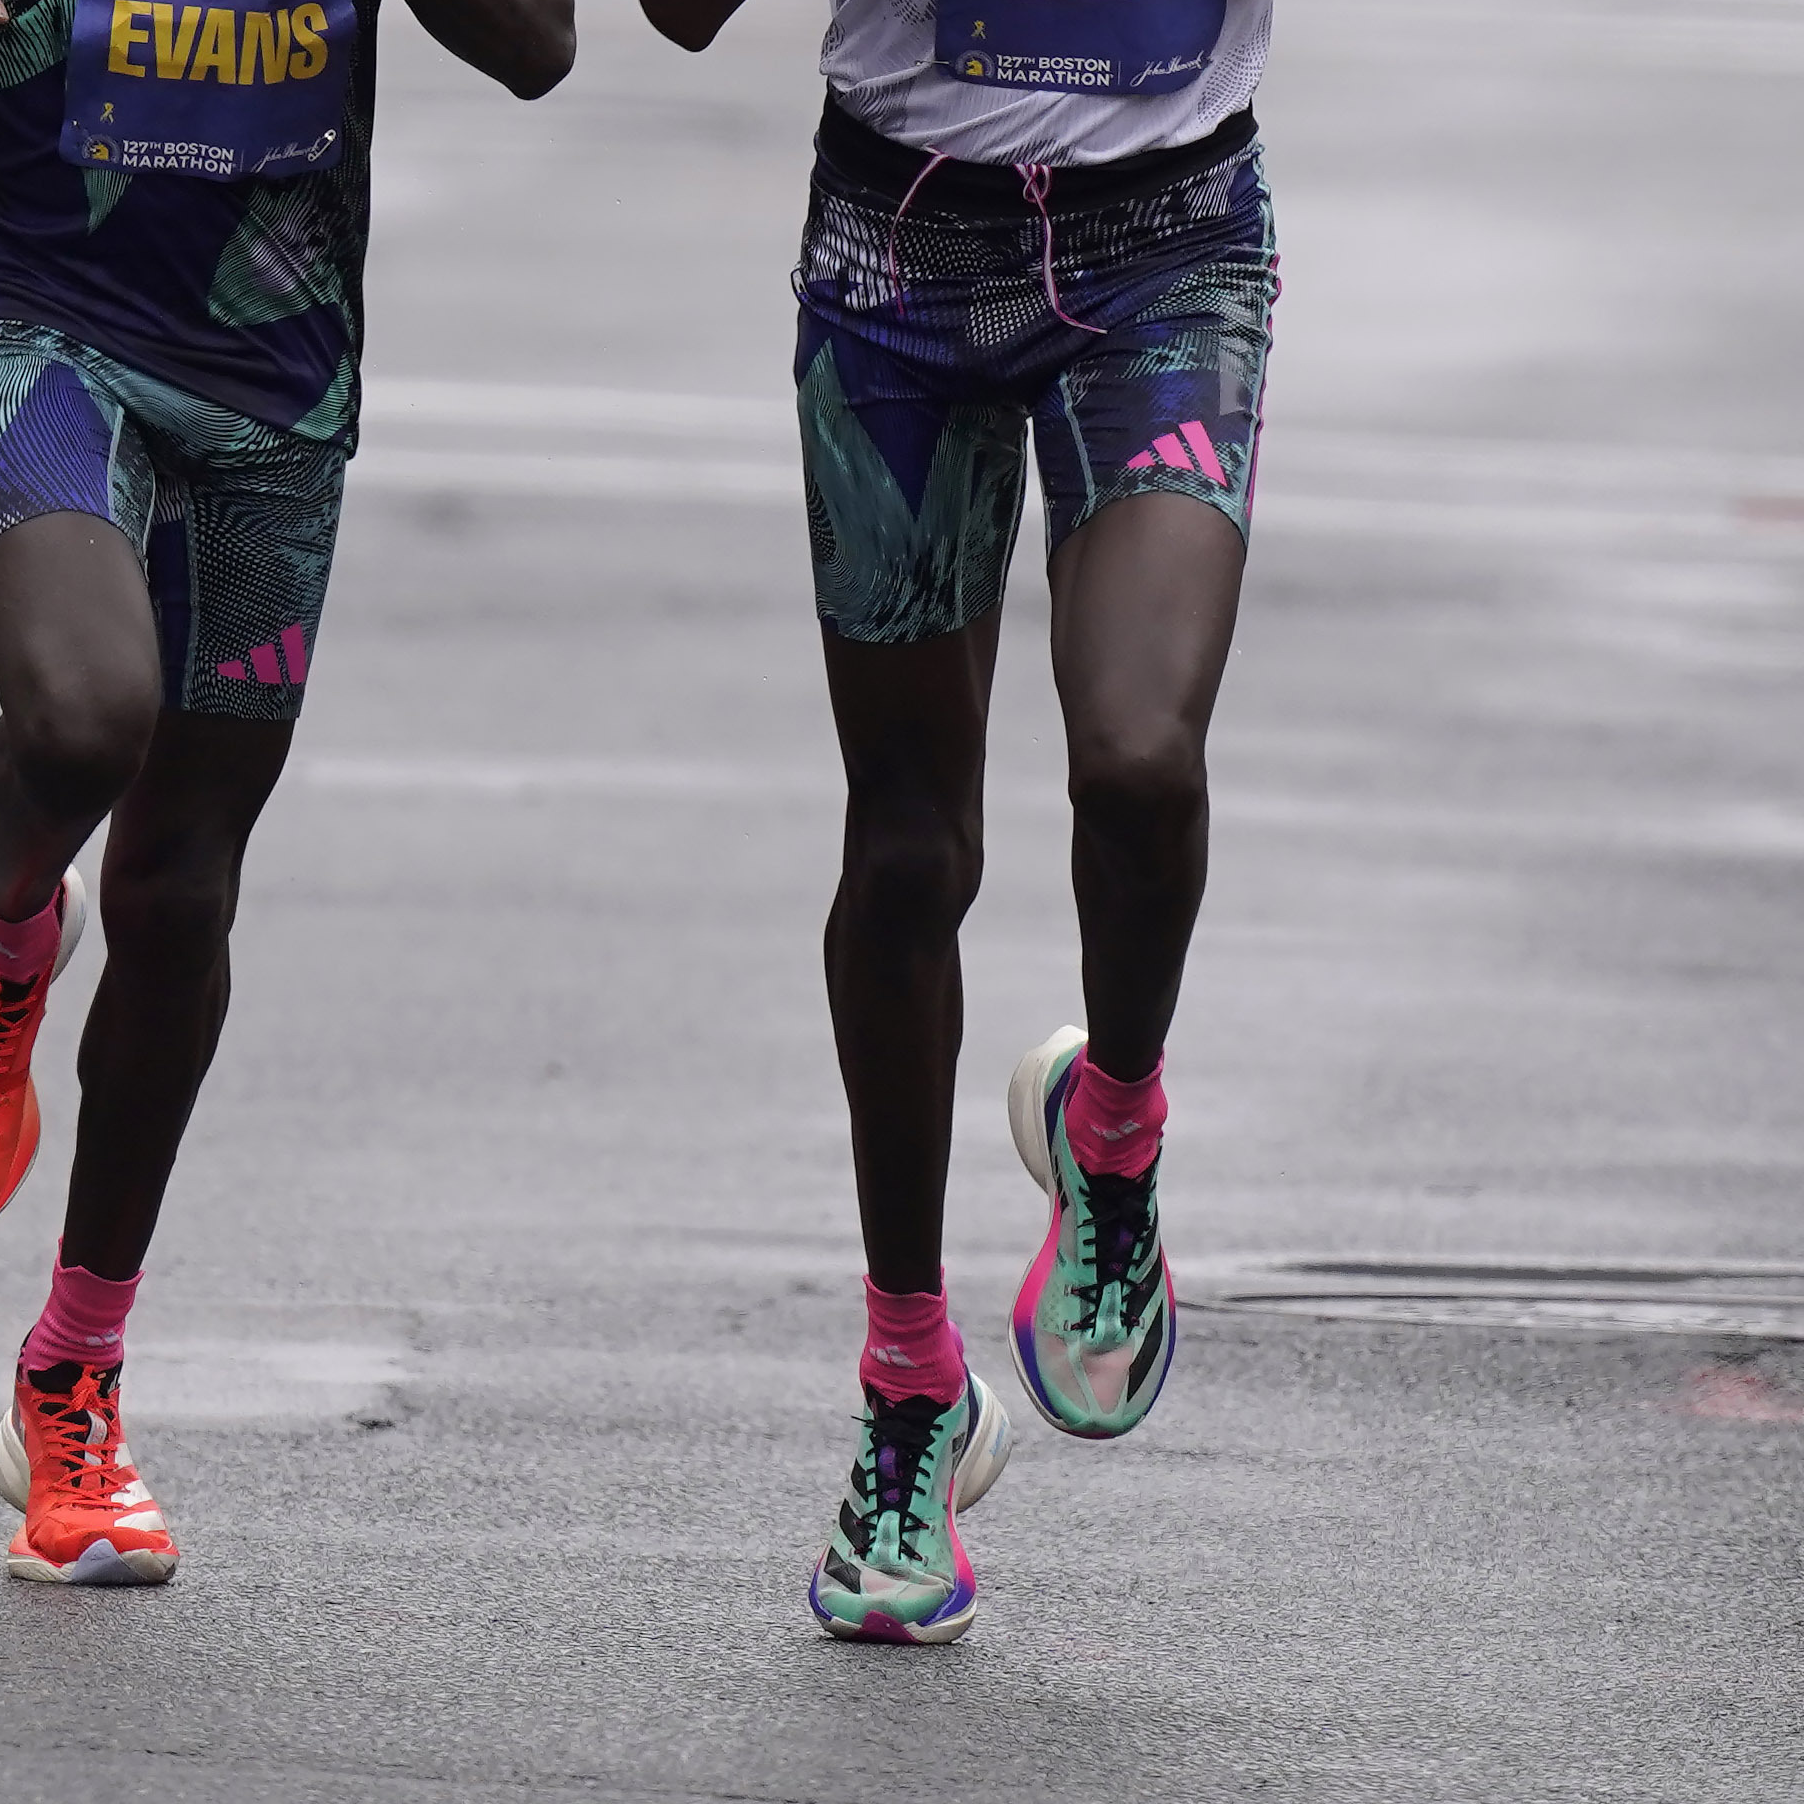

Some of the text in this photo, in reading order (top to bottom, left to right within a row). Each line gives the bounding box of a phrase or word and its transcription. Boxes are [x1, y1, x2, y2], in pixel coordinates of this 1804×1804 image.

[108, 0, 329, 85] EVANS
[996, 54, 1111, 72] 127TH BOSTON
[997, 68, 1111, 87] MARATHON
[122, 139, 162, 154] 127TH
[163, 142, 235, 161] BOSTON
[122, 154, 233, 175] MARATHON
